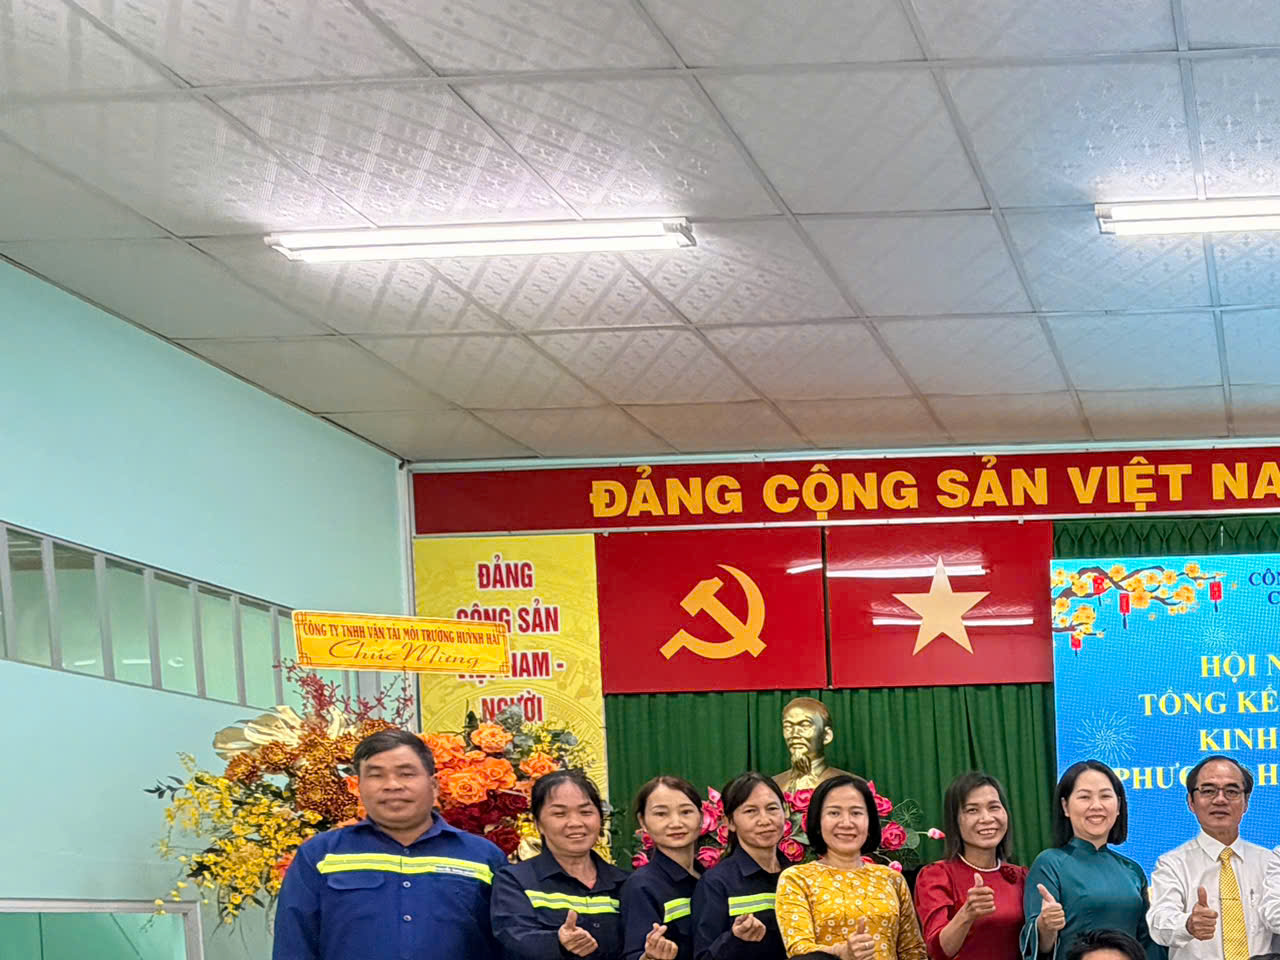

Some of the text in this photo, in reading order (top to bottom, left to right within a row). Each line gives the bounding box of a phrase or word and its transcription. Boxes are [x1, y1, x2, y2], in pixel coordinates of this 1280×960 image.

[589, 465, 742, 518] ĐẢNG
[762, 463, 918, 520] CỘNG
[936, 455, 1048, 508] SẢN
[1067, 456, 1192, 511] VIỆT
[477, 554, 533, 589] ĐẢNG
[304, 620, 327, 636] CÔNG
[328, 624, 339, 637] TY
[341, 625, 366, 638] TNHH
[367, 623, 385, 642] VẬN
[403, 625, 420, 641] MÔI
[518, 598, 559, 633] SẢN
[328, 639, 397, 661] Chúc
[1200, 651, 1257, 683] HỘI
[1138, 686, 1227, 716] TỔNG
[1199, 727, 1278, 751] KINH
